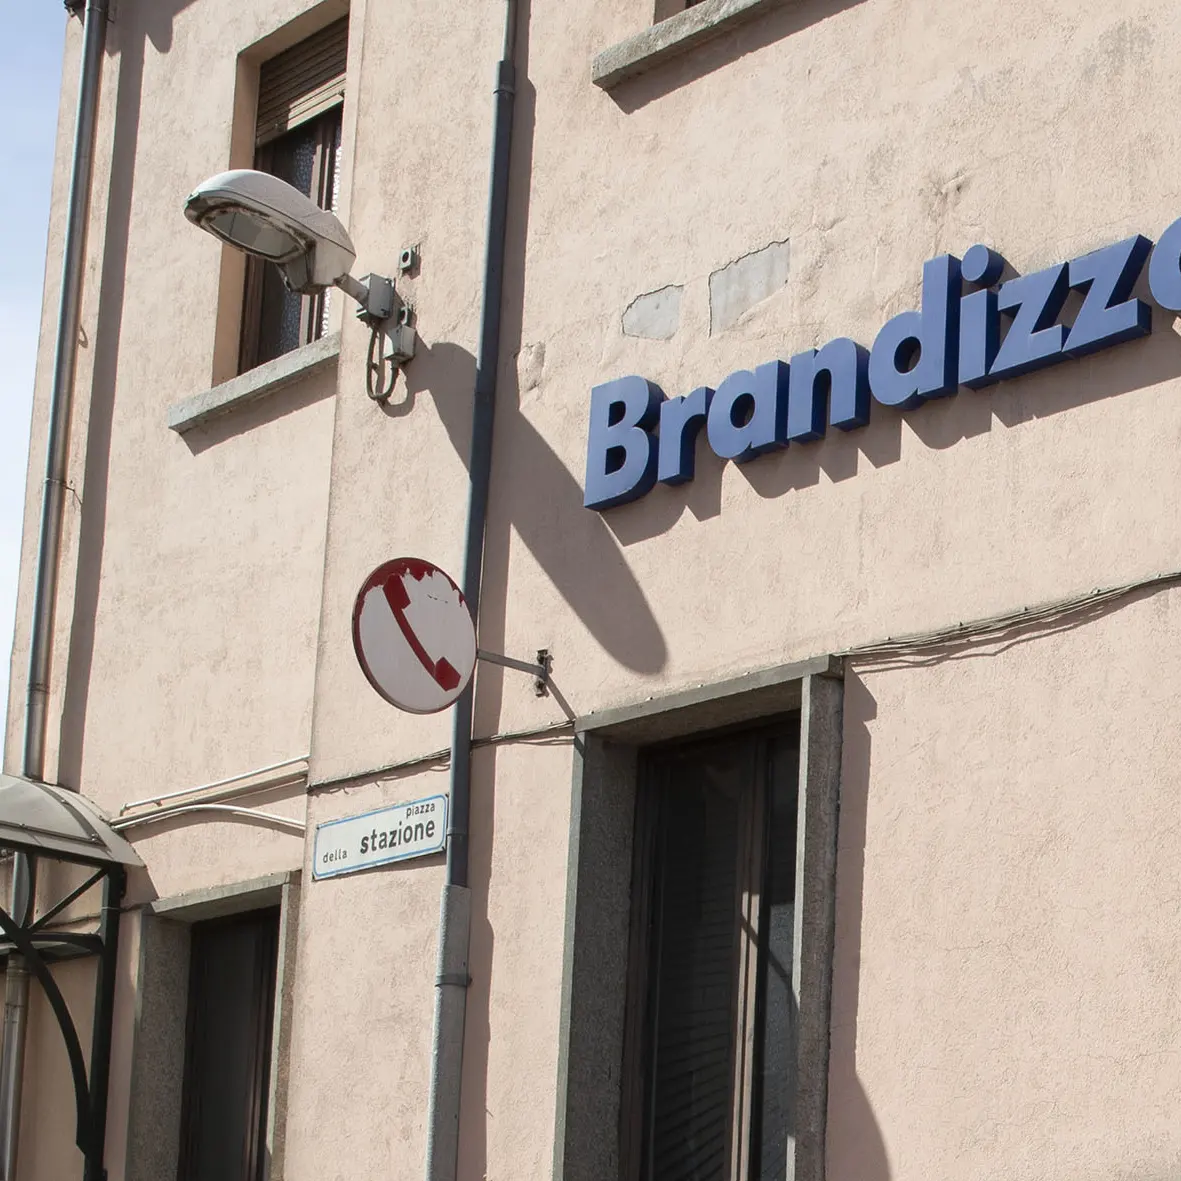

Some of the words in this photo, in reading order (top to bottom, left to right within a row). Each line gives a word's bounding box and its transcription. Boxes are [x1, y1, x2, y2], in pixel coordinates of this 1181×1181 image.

[405, 802, 435, 819] piazza
[322, 848, 348, 864] della
[360, 819, 435, 854] stazione
